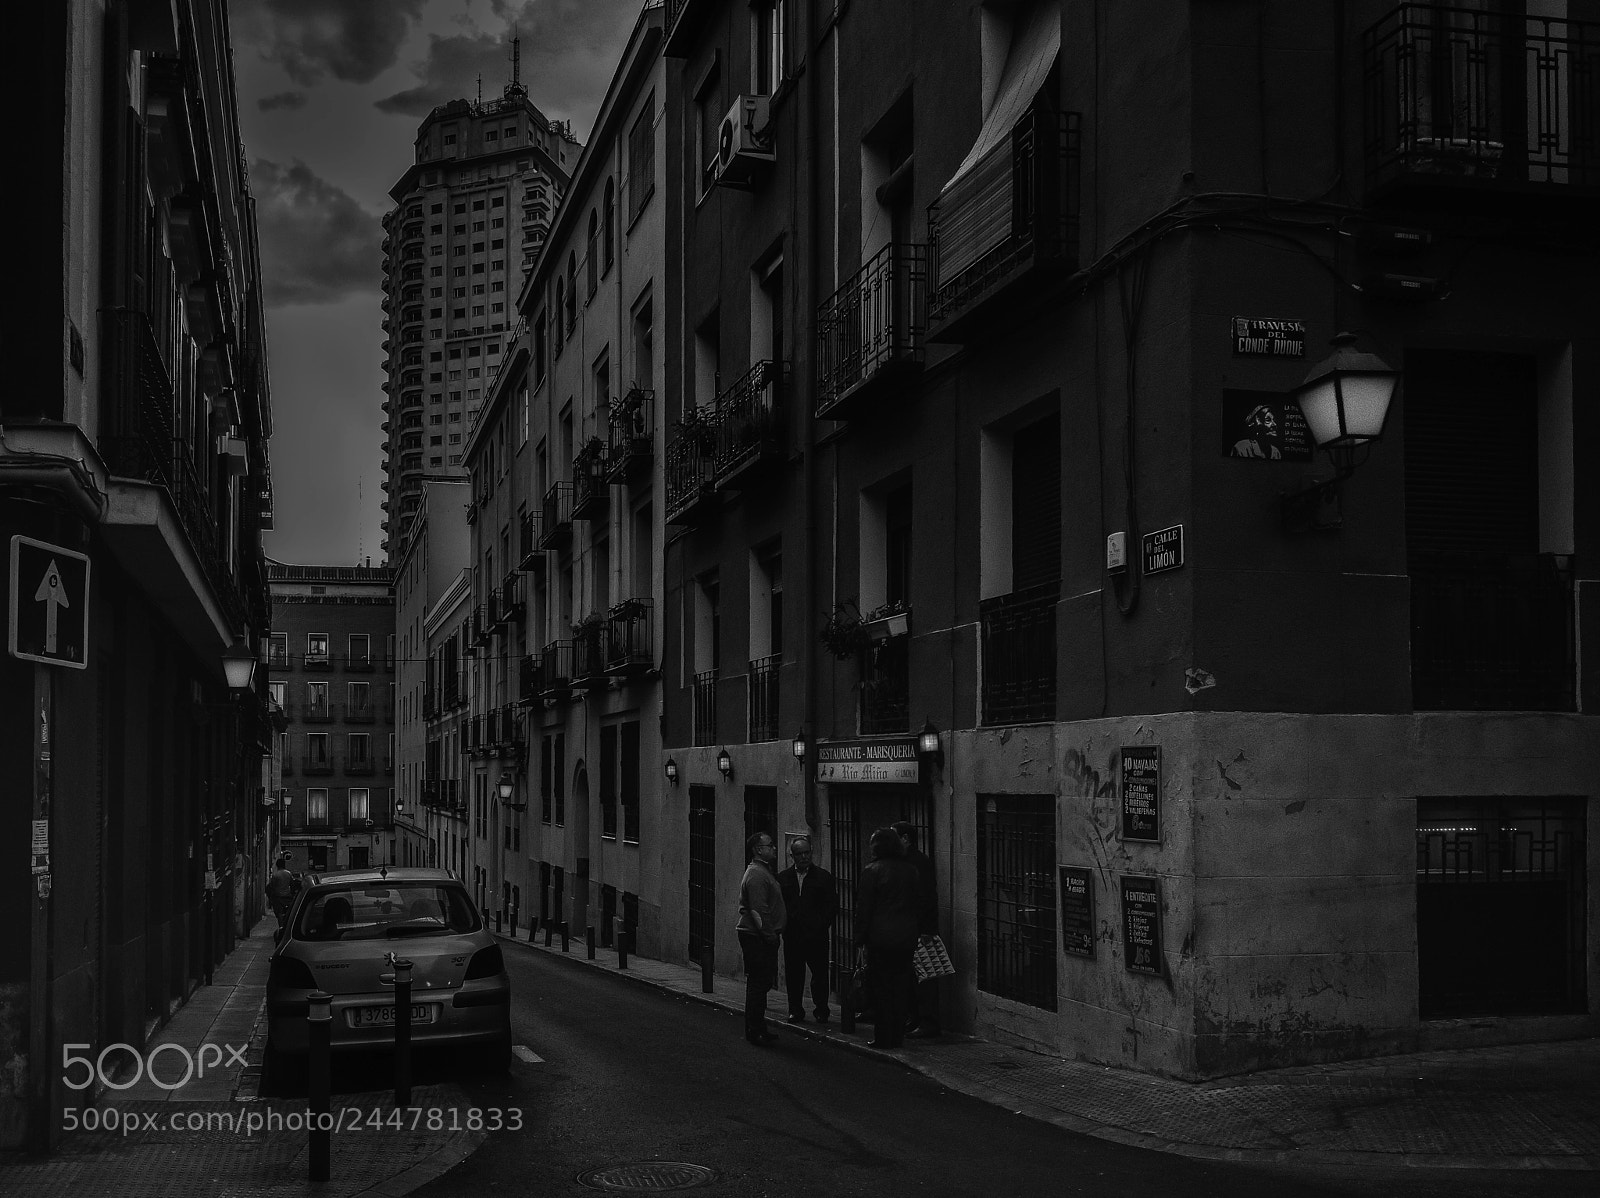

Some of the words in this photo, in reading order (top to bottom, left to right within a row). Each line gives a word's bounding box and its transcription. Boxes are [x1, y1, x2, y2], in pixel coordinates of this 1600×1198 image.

[1267, 331, 1287, 339] DEL
[1238, 337, 1270, 354] CONDE
[1273, 339, 1304, 356] DUQUE
[1154, 530, 1178, 545] CALLE
[1153, 544, 1165, 554] DEL
[1149, 549, 1175, 571] LIMÓN
[818, 746, 862, 760] RESTAURANTE
[1123, 757, 1132, 771] 10
[1124, 773, 1128, 783] 2
[366, 1007, 396, 1021] 3786
